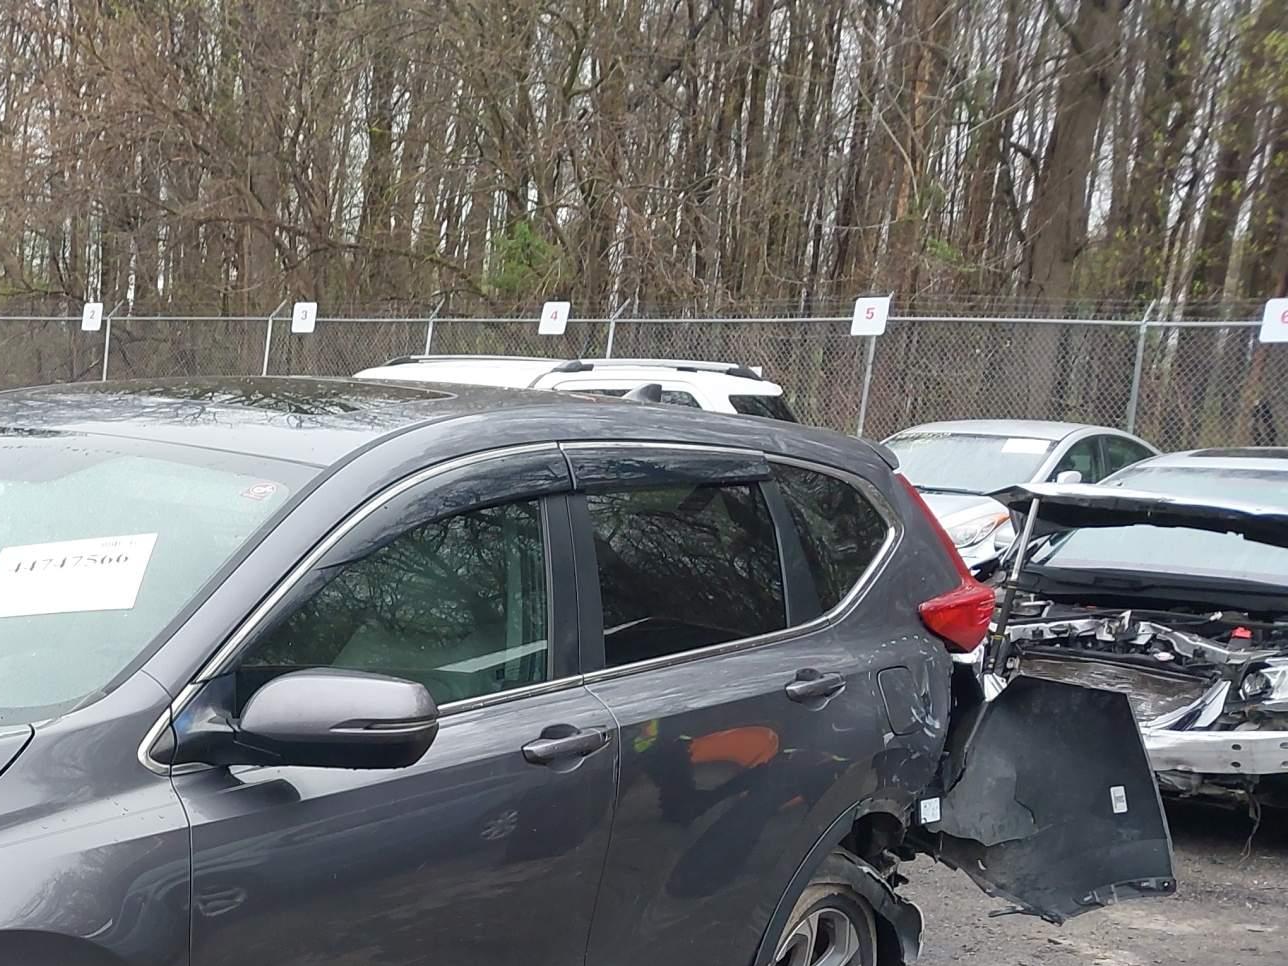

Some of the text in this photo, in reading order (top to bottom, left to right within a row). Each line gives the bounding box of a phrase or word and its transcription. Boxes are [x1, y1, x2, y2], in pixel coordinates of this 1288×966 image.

[300, 310, 307, 320] 3
[549, 311, 558, 321] 4
[865, 307, 875, 319] 5
